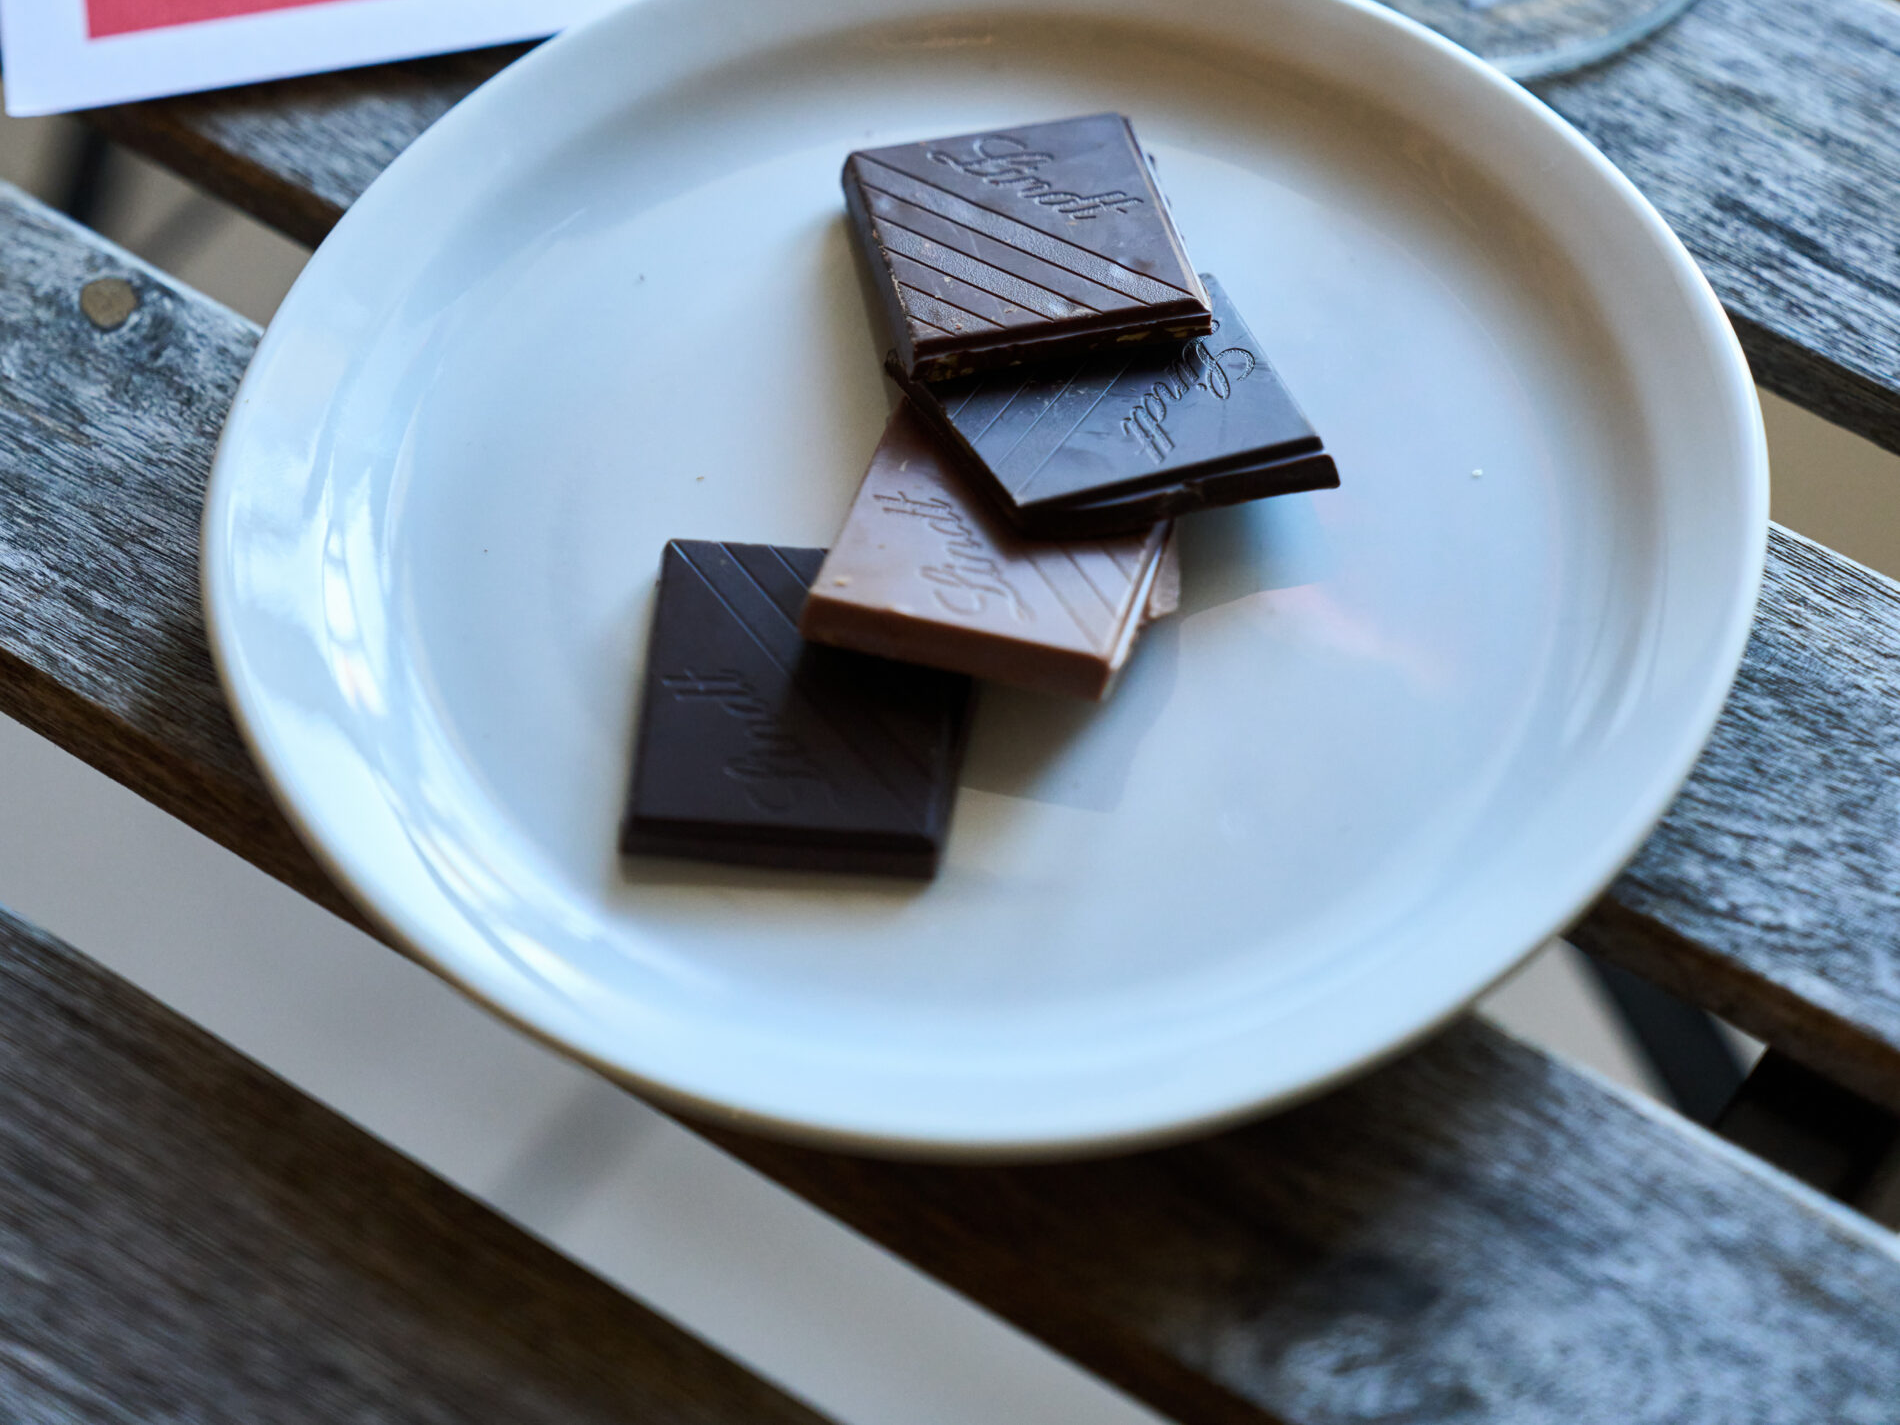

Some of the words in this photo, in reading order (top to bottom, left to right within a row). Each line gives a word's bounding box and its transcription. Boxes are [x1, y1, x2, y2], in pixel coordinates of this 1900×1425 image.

[926, 135, 1144, 220] Lindt
[1120, 320, 1256, 465] Lindt
[873, 491, 1037, 622] Lindt
